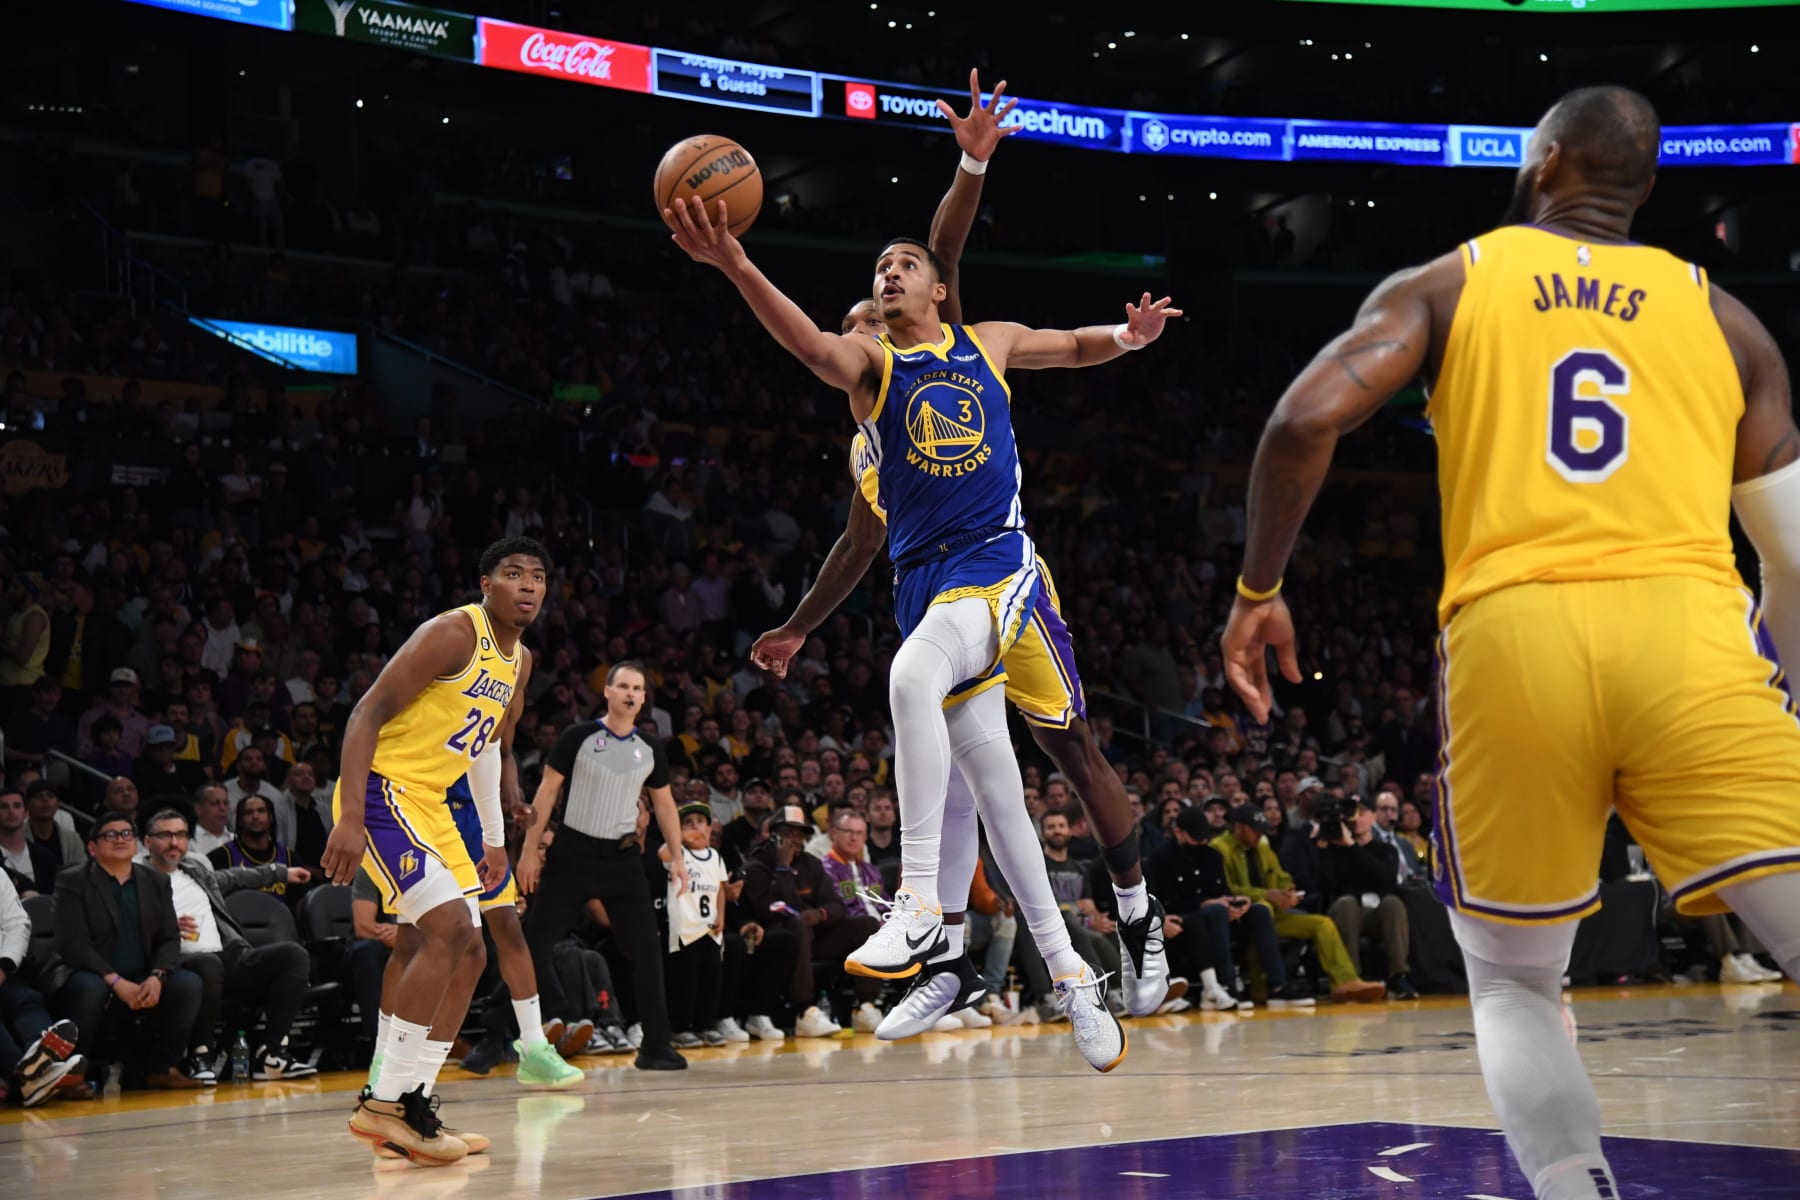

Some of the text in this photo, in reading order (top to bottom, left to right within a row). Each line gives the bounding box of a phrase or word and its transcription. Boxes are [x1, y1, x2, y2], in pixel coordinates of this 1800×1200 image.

[521, 33, 615, 79] Coca-Cola
[700, 72, 767, 96] & Guests
[879, 95, 949, 118] TOYOTA
[994, 102, 1105, 139] Spectrum
[1170, 128, 1271, 147] crypto.com
[1298, 134, 1441, 152] AMERICAN EXPRESS
[1466, 132, 1516, 157] UCLA
[1663, 135, 1771, 155] crypto.com
[686, 149, 751, 190] Wilson
[1533, 273, 1647, 322] JAMES
[950, 372, 985, 394] STATE
[957, 400, 973, 423] 3
[1546, 347, 1630, 483] 6
[906, 443, 991, 477] WARRIORS
[461, 668, 513, 709] LAKERS
[445, 707, 496, 759] 28
[700, 894, 711, 918] 6
